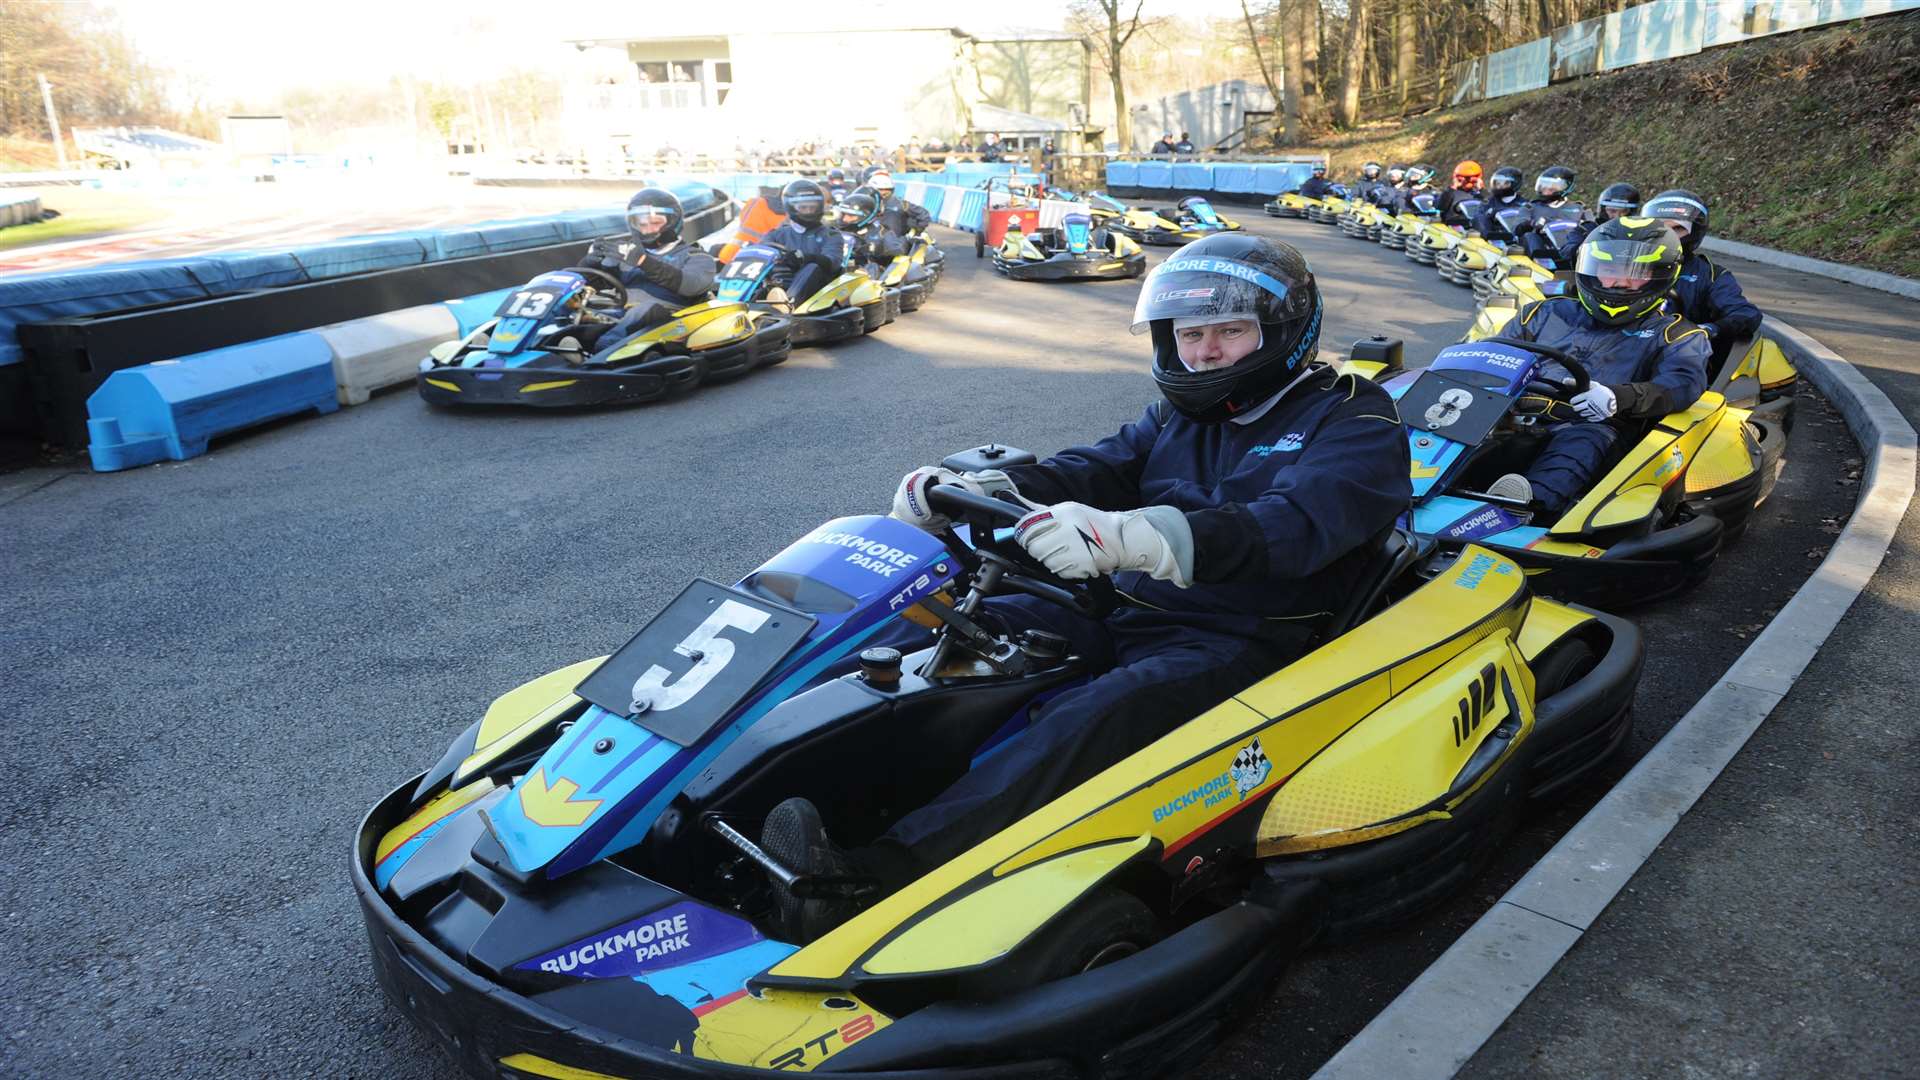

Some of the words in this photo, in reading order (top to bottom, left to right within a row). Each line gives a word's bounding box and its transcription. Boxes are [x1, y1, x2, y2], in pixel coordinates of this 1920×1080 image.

[726, 262, 763, 279] 14
[1213, 260, 1262, 283] PARK
[506, 291, 553, 318] 13
[1441, 350, 1526, 366] BUCKMORE
[1486, 358, 1520, 370] PARK
[1424, 388, 1474, 427] 8
[1450, 509, 1499, 537] BUCKMORE
[1484, 518, 1502, 529] PARK
[844, 552, 901, 578] PARK
[889, 574, 930, 611] RT8
[631, 599, 772, 712] 5
[1152, 772, 1231, 823] BUCKMORE
[1204, 786, 1233, 809] PARK
[539, 914, 690, 975] BUCKMORE
[635, 933, 692, 964] PARK
[769, 1014, 876, 1071] RT8
